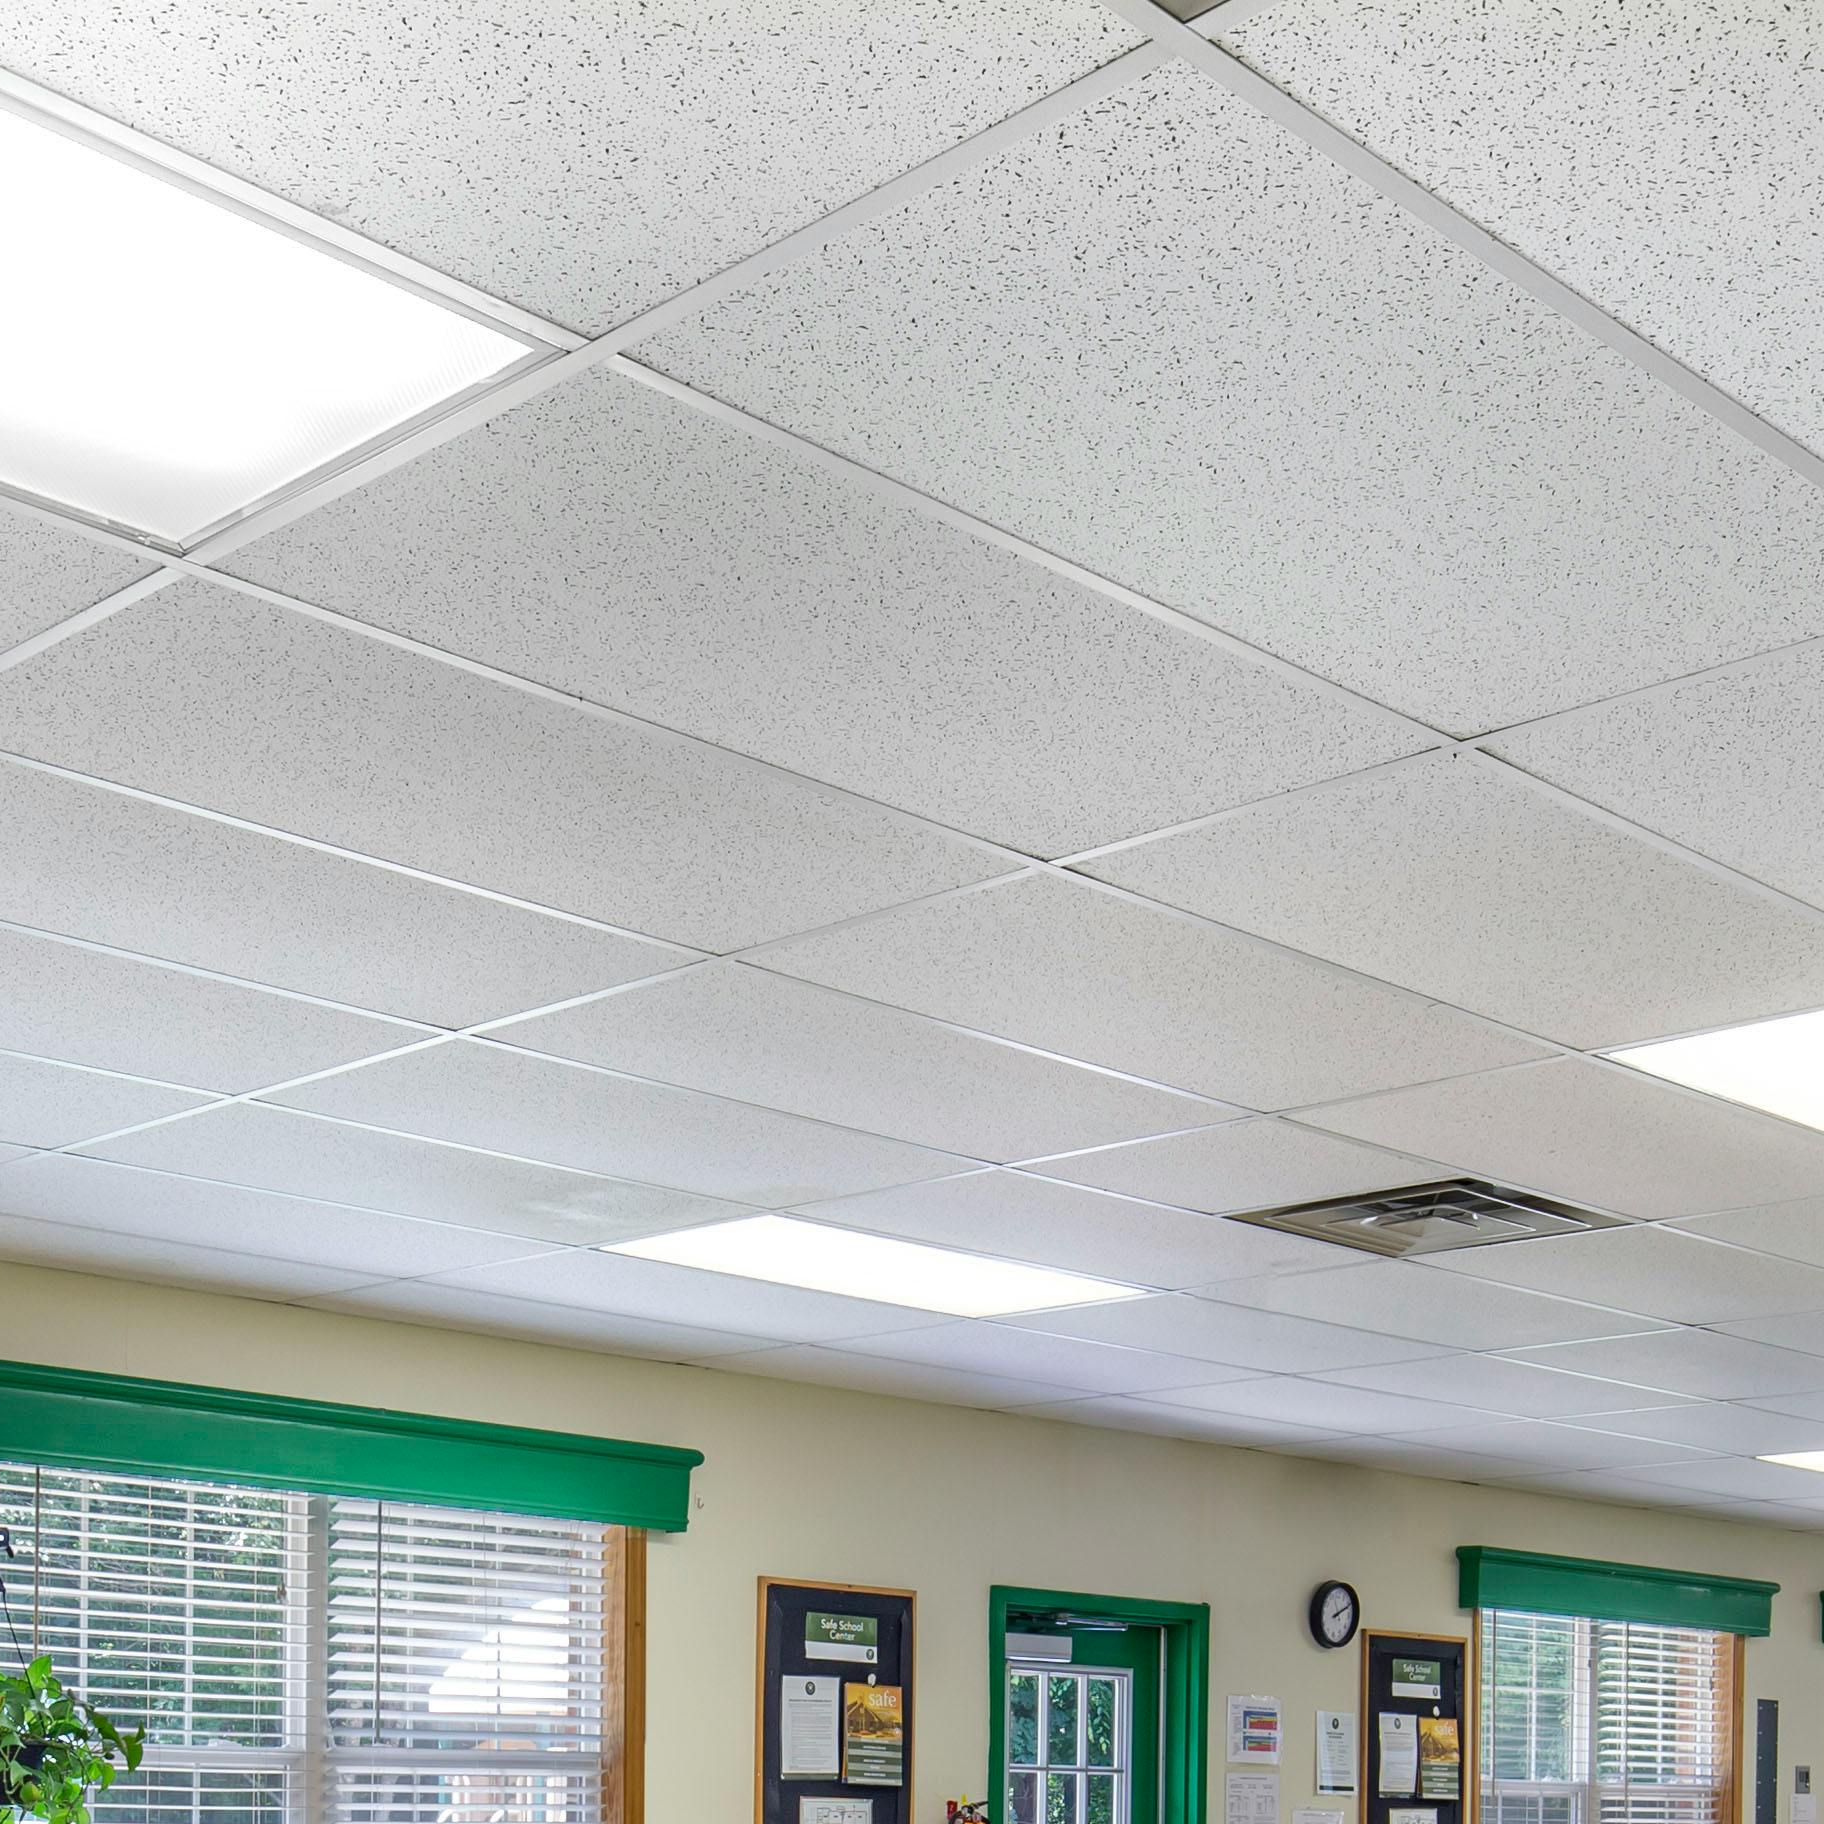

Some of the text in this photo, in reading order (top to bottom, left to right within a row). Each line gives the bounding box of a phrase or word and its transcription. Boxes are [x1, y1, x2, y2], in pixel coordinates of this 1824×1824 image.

[820, 1618, 864, 1632] Safe School
[829, 1629, 856, 1641] Center
[868, 1689, 897, 1708] safe
